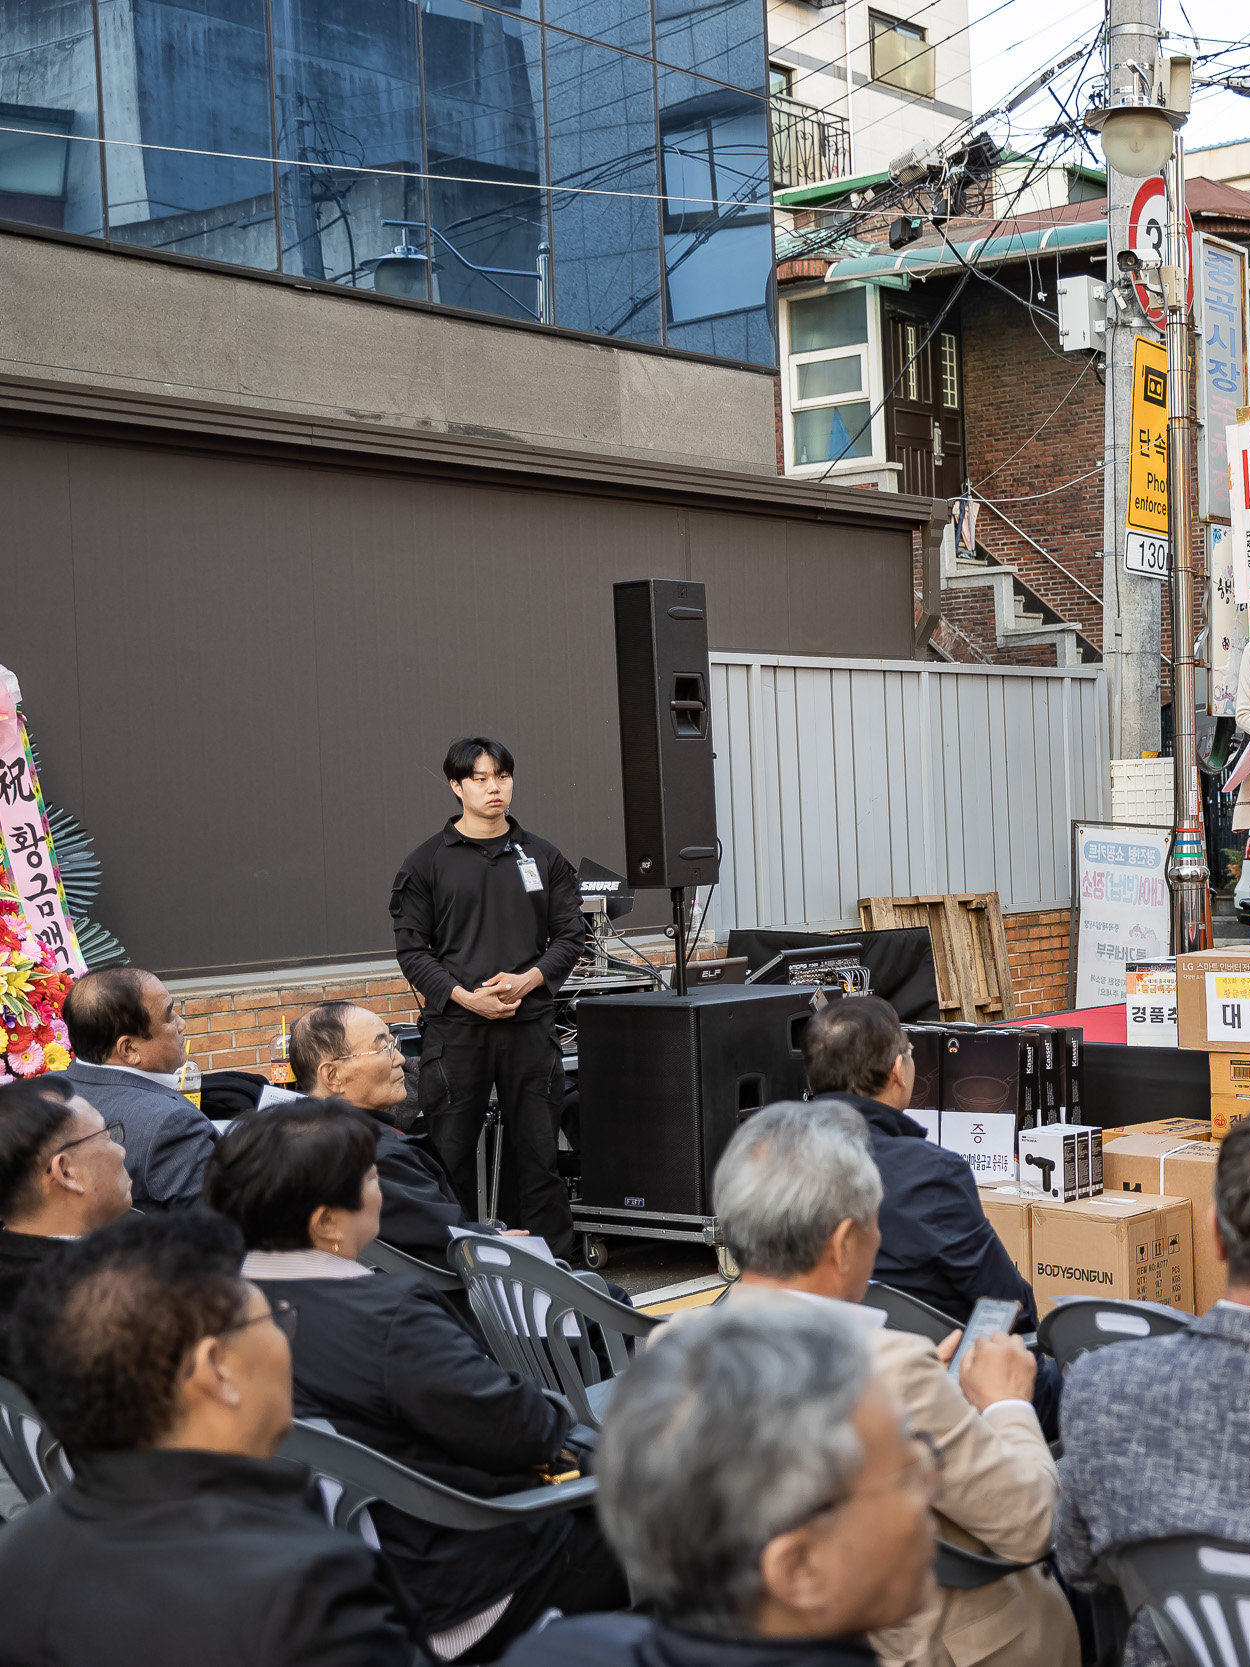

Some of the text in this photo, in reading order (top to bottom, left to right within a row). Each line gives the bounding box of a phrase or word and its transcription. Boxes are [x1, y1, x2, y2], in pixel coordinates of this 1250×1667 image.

[1204, 249, 1241, 393] 중곡시장
[1147, 472, 1169, 494] Pho
[0, 756, 36, 806] 祝
[580, 881, 622, 891] SHURE
[9, 822, 78, 983] 황금맥
[701, 969, 722, 978] ELF
[1182, 962, 1194, 971] LG
[1196, 963, 1219, 971] 스마트
[970, 1123, 987, 1144] 증
[1037, 1262, 1113, 1285] BODYSONGUN
